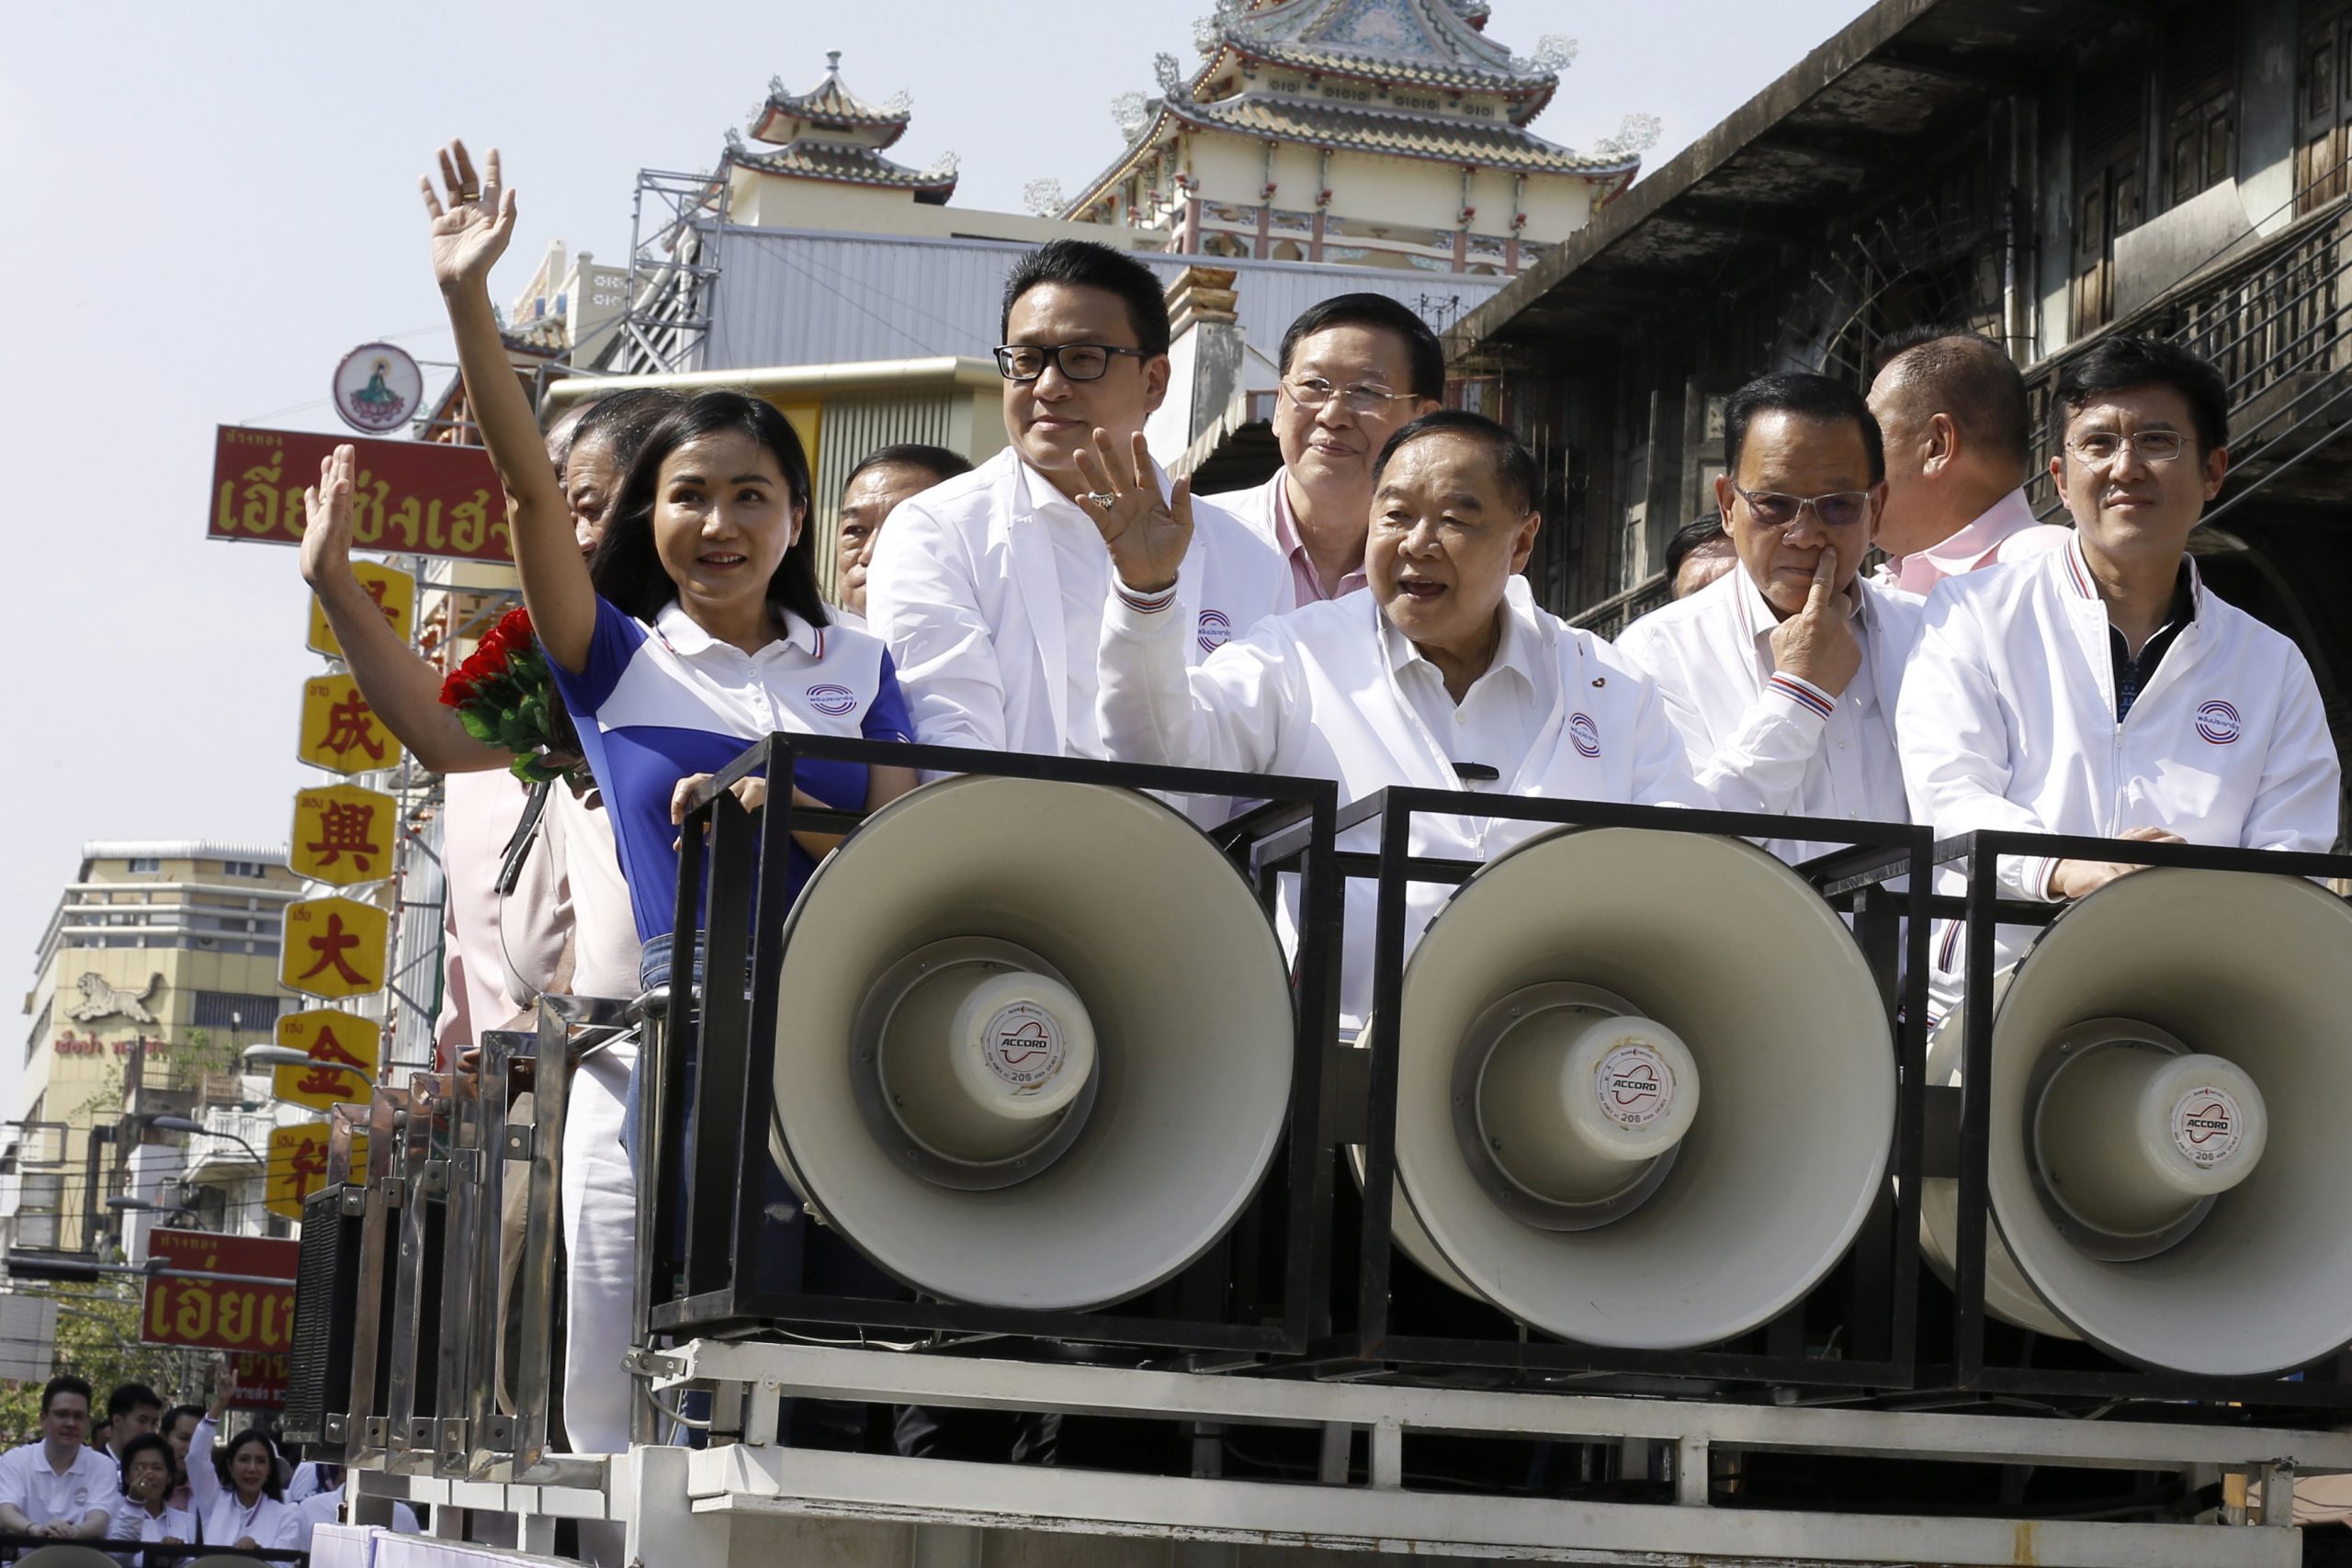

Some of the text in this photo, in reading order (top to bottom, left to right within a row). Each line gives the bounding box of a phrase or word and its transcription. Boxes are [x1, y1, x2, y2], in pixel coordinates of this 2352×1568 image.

[317, 689, 384, 760] 成
[299, 912, 371, 986] 大
[1001, 1038, 1047, 1048] ACCORD
[297, 1025, 370, 1098] 金
[1612, 1079, 1657, 1091] ACCORD
[2187, 1119, 2228, 1130] ACCORD
[161, 1235, 218, 1250] ห้างทอง
